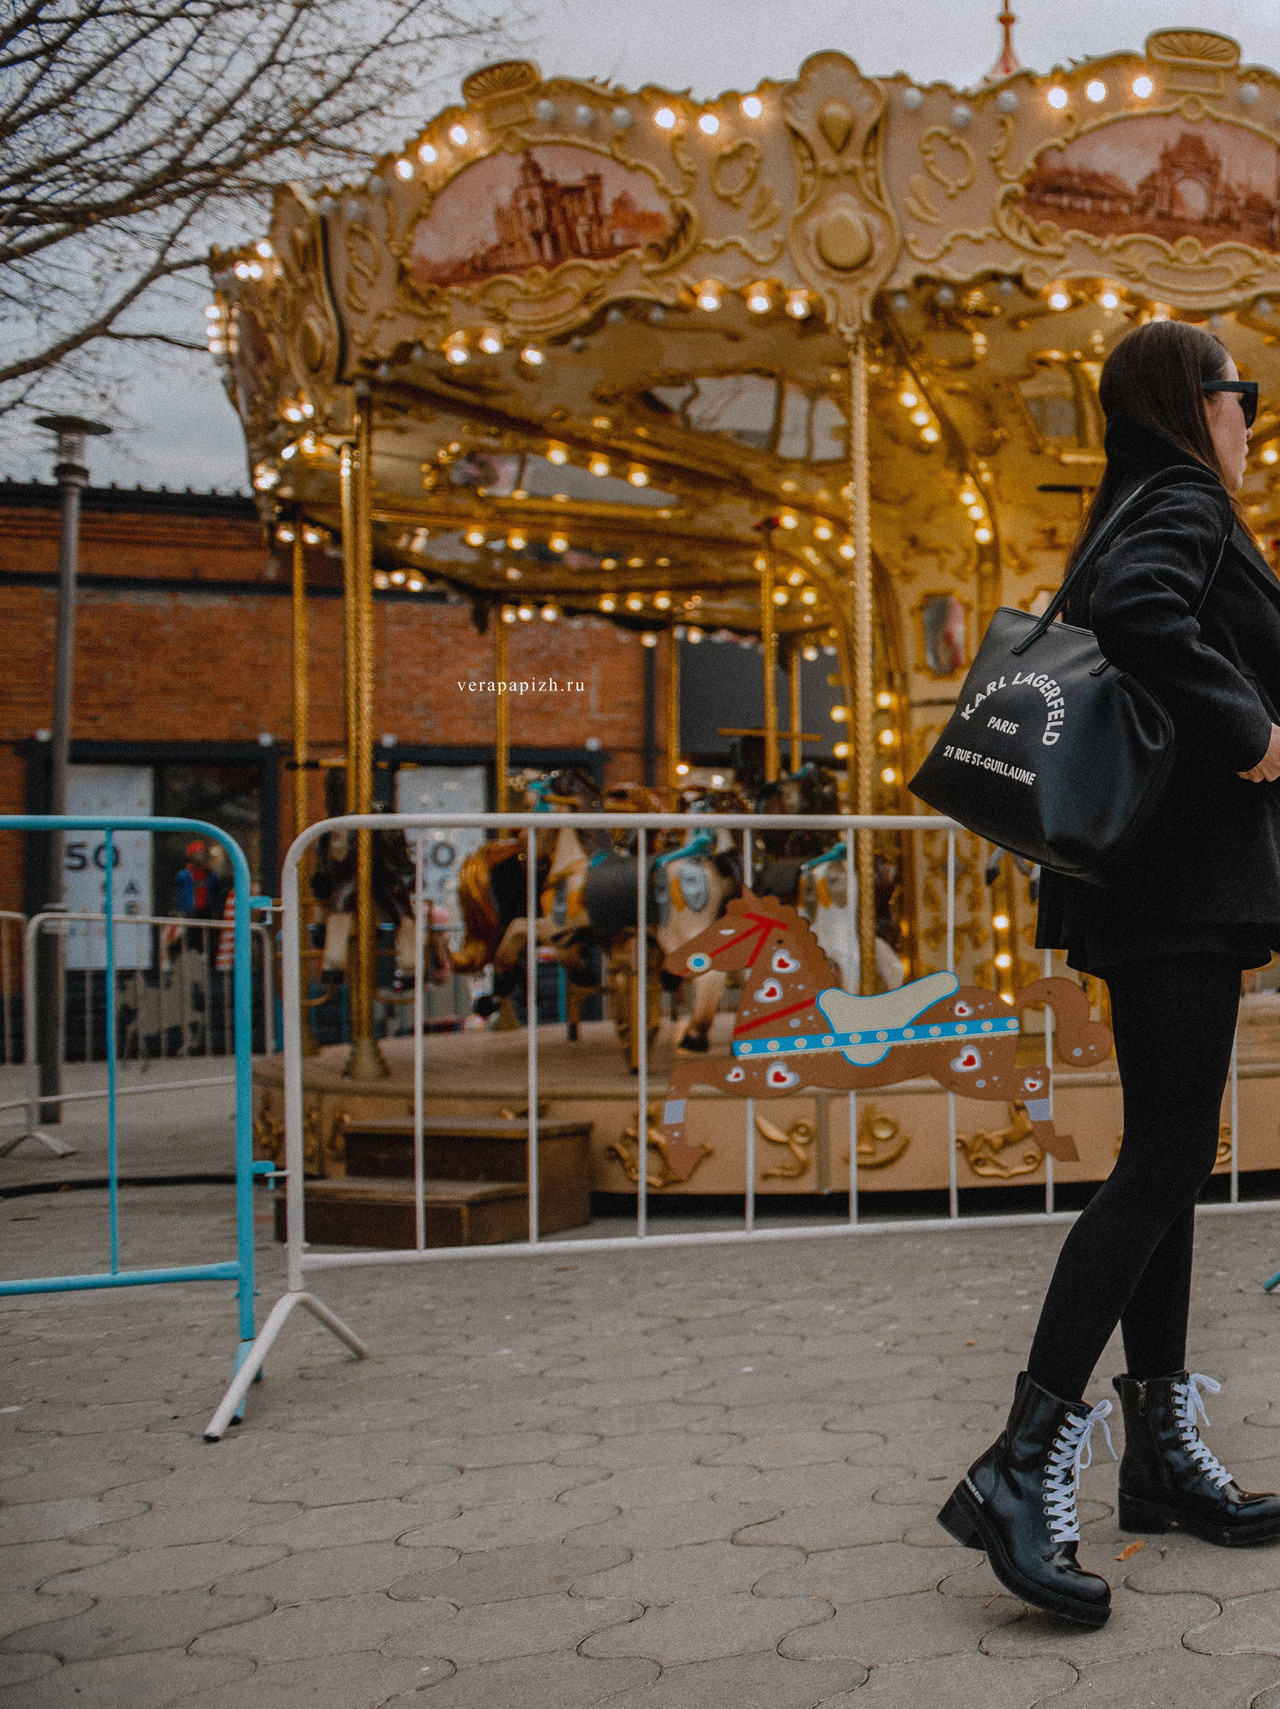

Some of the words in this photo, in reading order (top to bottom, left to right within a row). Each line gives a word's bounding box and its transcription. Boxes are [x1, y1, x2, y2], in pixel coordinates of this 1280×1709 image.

[961, 676, 1007, 720] KARL
[1012, 672, 1065, 746] LAGERFELD
[987, 716, 1019, 735] PARIS
[943, 745, 954, 757] 21
[954, 748, 972, 763] RUE
[971, 753, 1036, 786] ST-GUILLAUME
